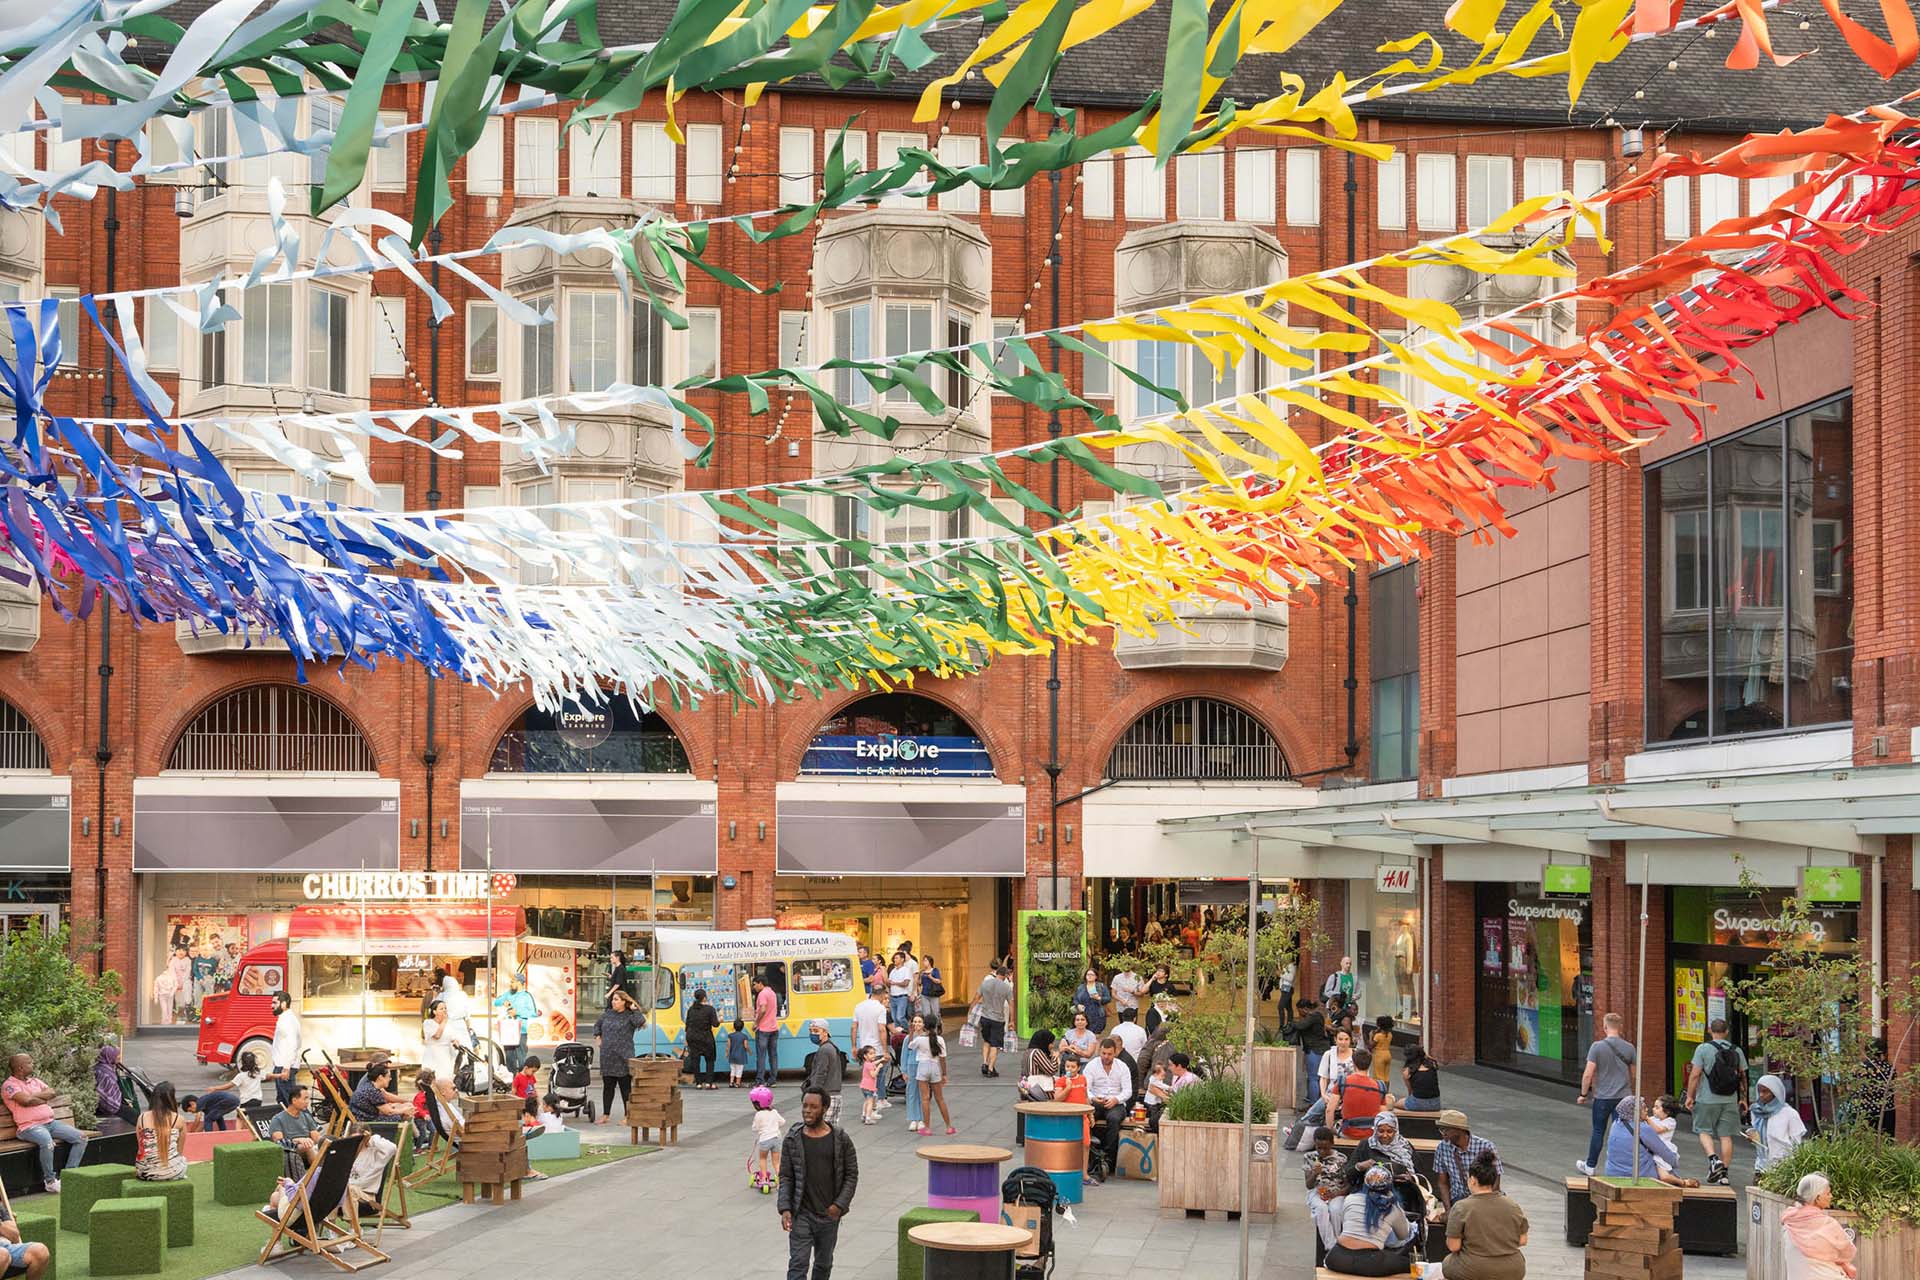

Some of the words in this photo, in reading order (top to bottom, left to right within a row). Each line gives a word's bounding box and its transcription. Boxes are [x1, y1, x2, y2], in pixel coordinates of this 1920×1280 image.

[564, 712, 605, 722] Explre
[856, 740, 939, 761] Explore
[856, 767, 939, 775] LEARNING
[303, 872, 427, 899] CHURROS
[431, 872, 488, 898] TIME
[1508, 900, 1583, 926] Superdrug
[1714, 909, 1826, 942] Superdrg
[698, 941, 758, 950] TRADITIONAL
[799, 937, 829, 945] CREAM
[1034, 952, 1060, 961] amazon
[1061, 950, 1081, 958] fresh
